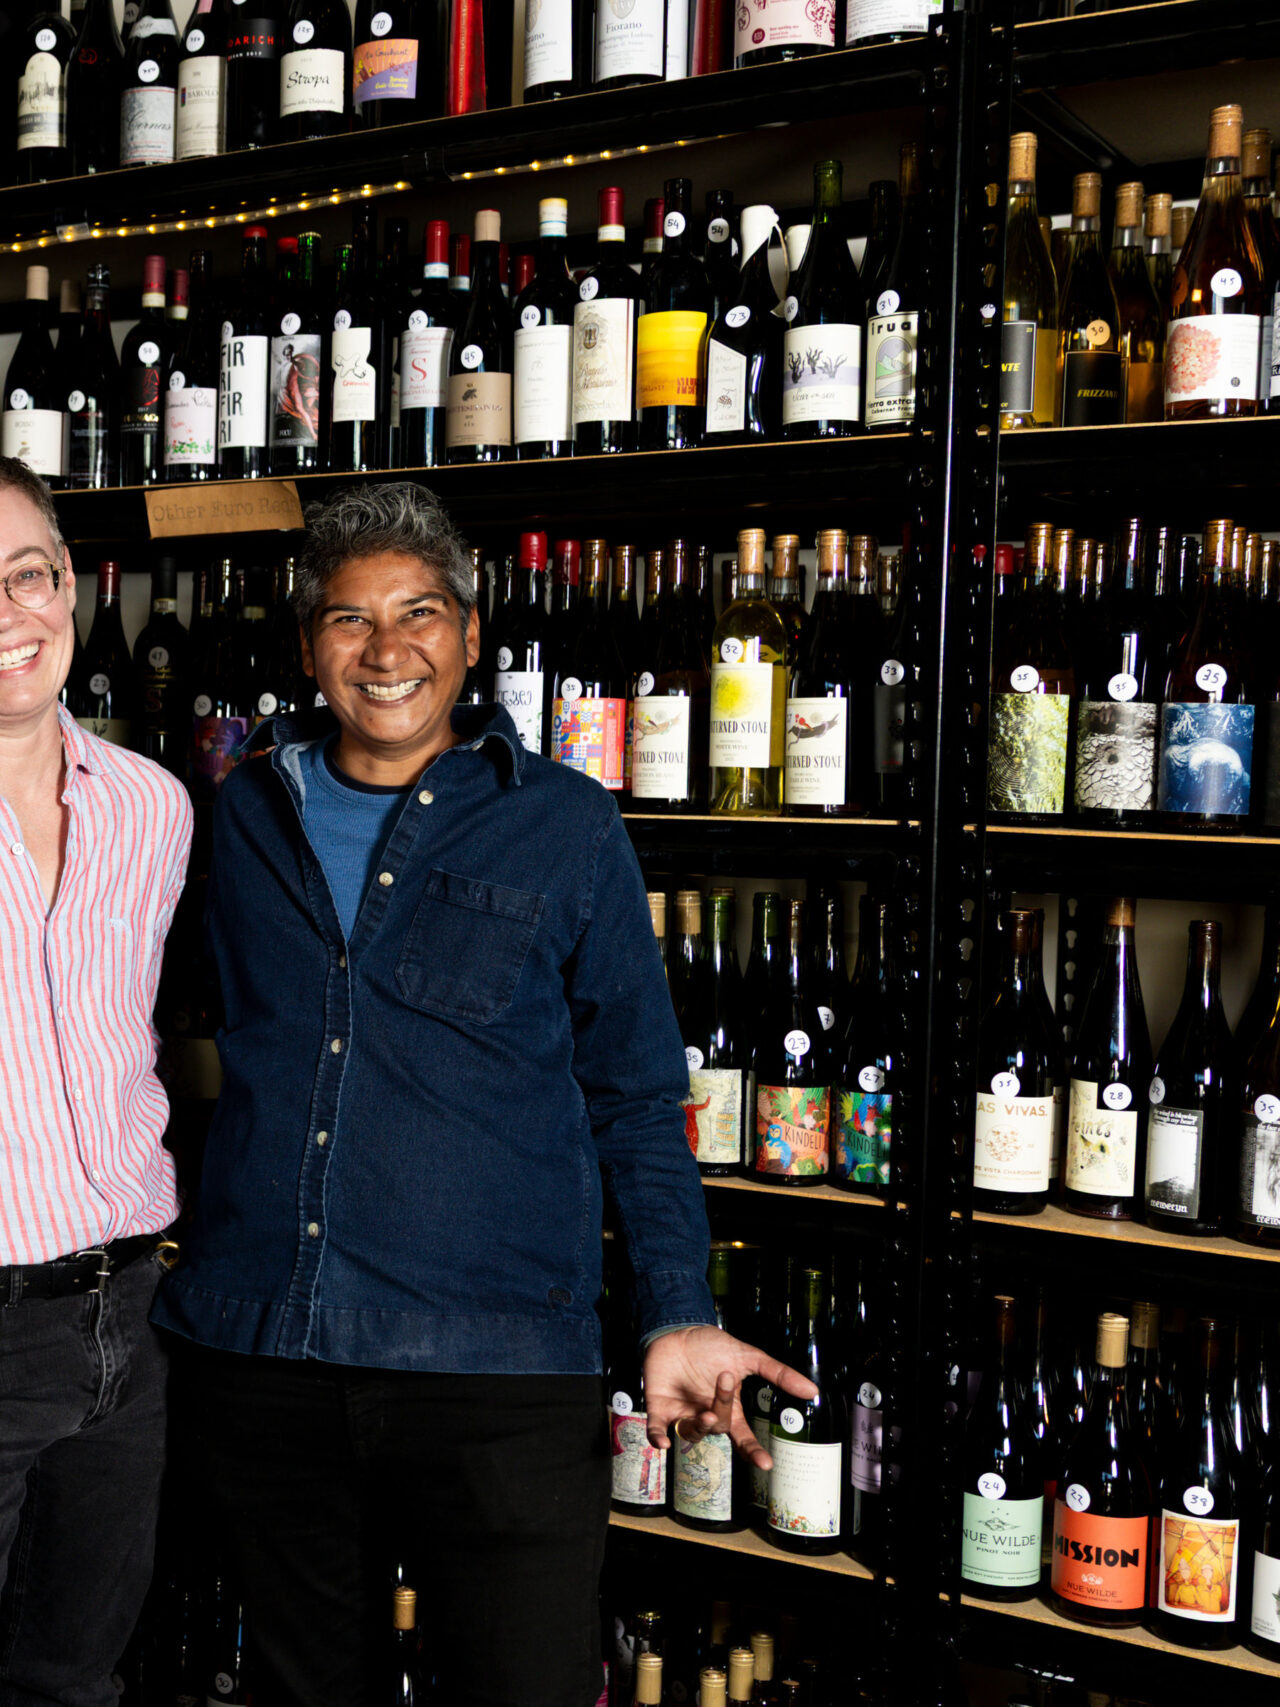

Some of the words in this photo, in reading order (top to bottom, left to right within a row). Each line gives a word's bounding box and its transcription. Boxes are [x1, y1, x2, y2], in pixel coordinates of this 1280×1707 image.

[374, 20, 386, 30] 70
[604, 20, 643, 32] Fiorano
[286, 71, 331, 90] Stropa
[666, 217, 680, 230] 54
[710, 225, 724, 237] 54
[1220, 275, 1236, 286] 45
[523, 311, 537, 321] 40
[729, 311, 747, 323] 73
[870, 320, 912, 337] irua
[1089, 326, 1104, 337] 30
[463, 351, 477, 363] 45
[410, 357, 429, 383] S
[152, 503, 206, 523] Other
[210, 500, 254, 518] Euro
[723, 642, 739, 655] 32
[884, 665, 898, 677] 33
[1201, 668, 1221, 684] 35
[740, 720, 768, 735] STONE
[657, 750, 686, 764] STONE
[813, 754, 843, 769] STONE
[788, 1037, 807, 1050] 27
[862, 1072, 880, 1083] 27
[1109, 1091, 1124, 1101] 28
[1004, 1104, 1048, 1117] VIVAS
[1260, 1100, 1275, 1114] 35
[784, 1125, 823, 1150] KINDELI
[982, 1479, 1000, 1492] 24
[1069, 1487, 1084, 1506] 22
[992, 1533, 1037, 1548] WILDE
[976, 1546, 1000, 1556] PINOT
[1002, 1548, 1022, 1557] NOIR
[1055, 1532, 1141, 1569] MISSION
[1066, 1580, 1085, 1593] NUE
[1086, 1586, 1119, 1599] WILDE
